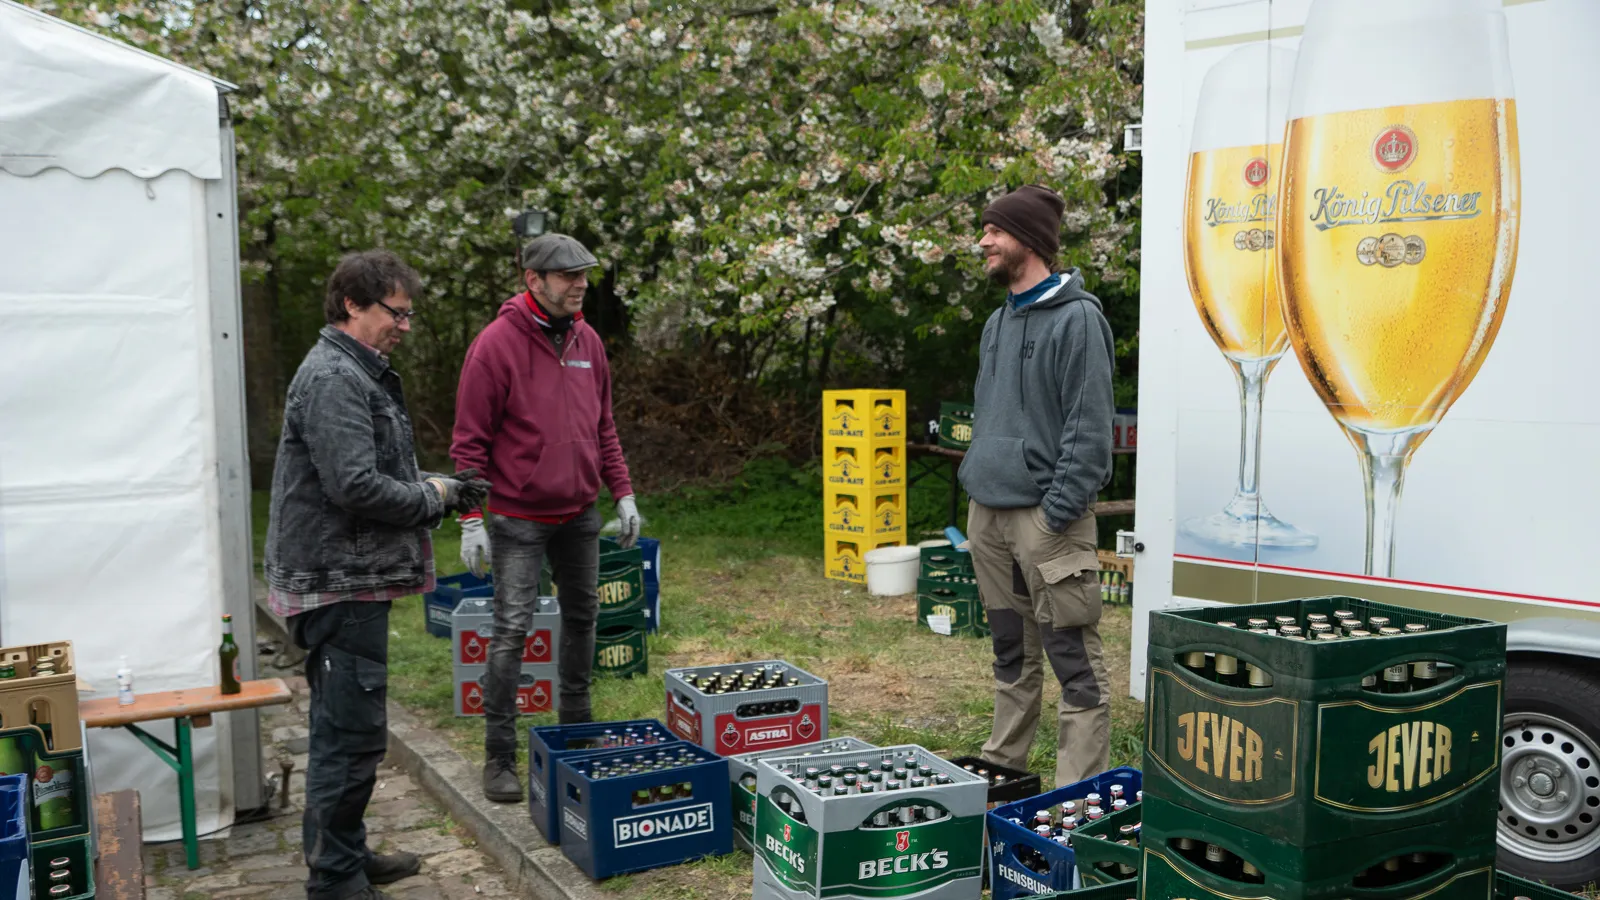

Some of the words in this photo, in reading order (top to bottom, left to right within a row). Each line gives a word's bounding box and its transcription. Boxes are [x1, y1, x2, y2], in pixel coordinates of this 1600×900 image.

[1204, 197, 1250, 224] König
[1310, 185, 1382, 224] König
[1381, 179, 1482, 217] Pilsener
[597, 581, 632, 604] JEVER
[598, 644, 634, 668] JEVER
[749, 728, 789, 741] ASTRA
[1177, 711, 1264, 783] JEVER
[1367, 721, 1453, 793] JEVER
[618, 808, 710, 841] BIONADE
[766, 833, 805, 874] BECK'S
[858, 848, 949, 880] BECK'S
